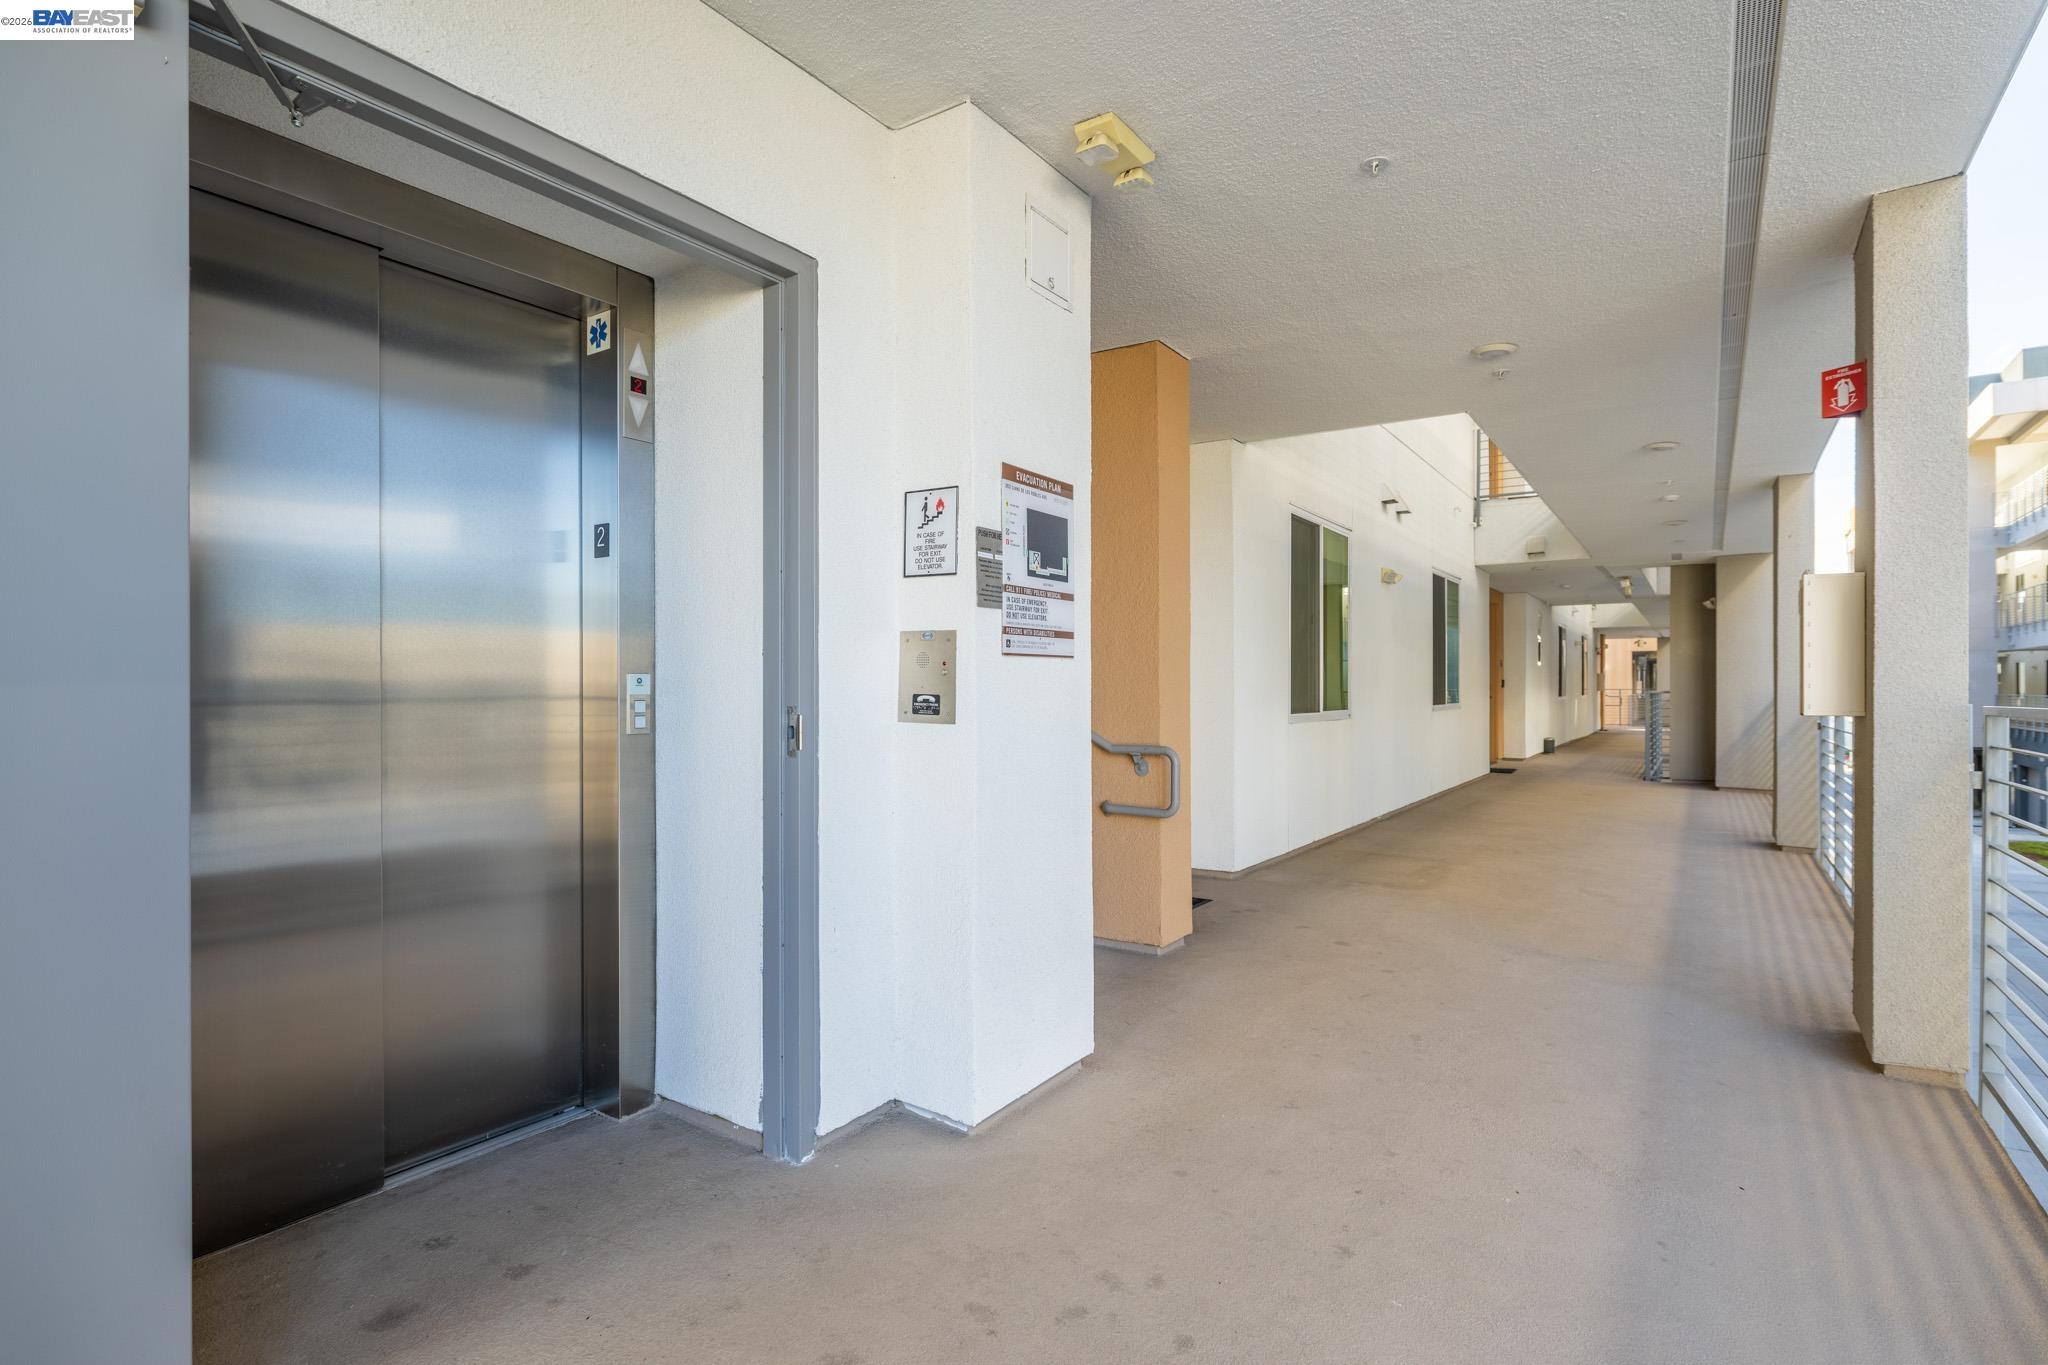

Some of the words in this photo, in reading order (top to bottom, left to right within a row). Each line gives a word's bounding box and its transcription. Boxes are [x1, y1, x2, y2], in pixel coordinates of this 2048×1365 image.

[633, 378, 642, 393] 2
[1016, 471, 1048, 489] EVACUATION
[1048, 482, 1062, 494] PLAN
[597, 526, 605, 547] 2
[1014, 604, 1032, 613] STAIRWAY
[1006, 627, 1022, 635] PERSONS
